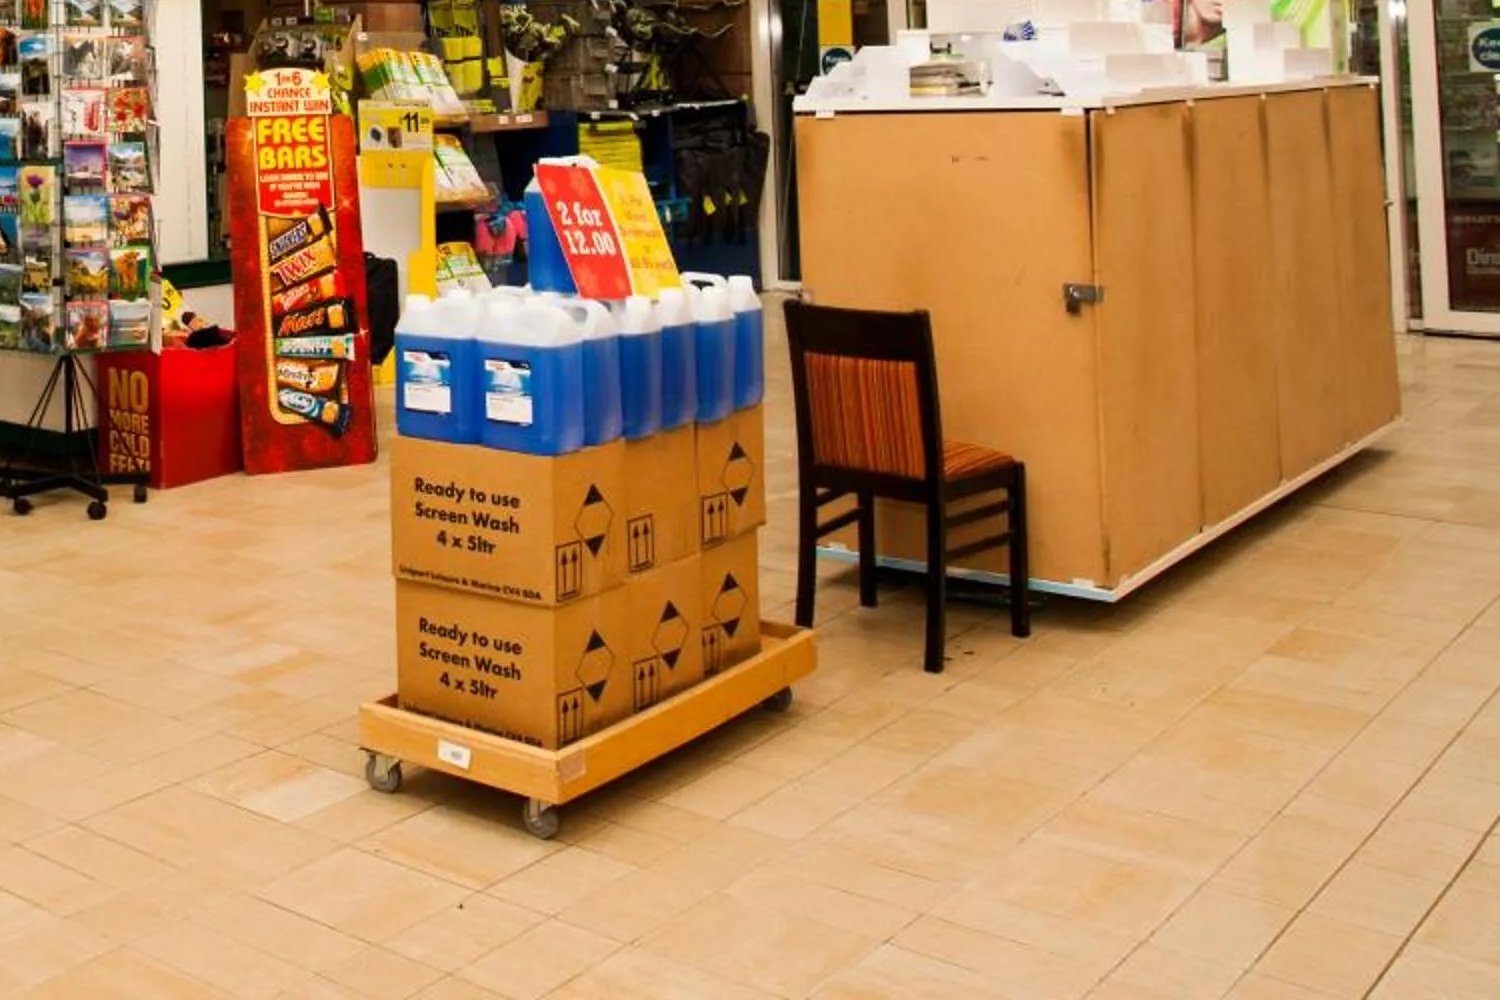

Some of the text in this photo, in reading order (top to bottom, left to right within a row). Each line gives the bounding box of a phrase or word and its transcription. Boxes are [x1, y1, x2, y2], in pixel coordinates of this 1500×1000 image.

[267, 87, 311, 99] CHANCE
[291, 71, 302, 86] 6
[250, 100, 329, 113] INSTANT WIN
[257, 117, 326, 145] FREE
[259, 144, 328, 171] BARS
[555, 199, 604, 228] 2 for
[563, 229, 617, 256] 12.00
[277, 250, 318, 287] TWIX
[108, 366, 150, 414] NO
[108, 408, 150, 435] MORE
[108, 429, 151, 458] COLD
[414, 476, 521, 510] Ready to use
[414, 500, 520, 535] Screen Wash
[436, 529, 497, 555] 4 x 5ltr
[419, 615, 523, 656] Ready to use
[419, 641, 522, 681] Screen Wash
[439, 671, 499, 700] 4 x 5ltr
